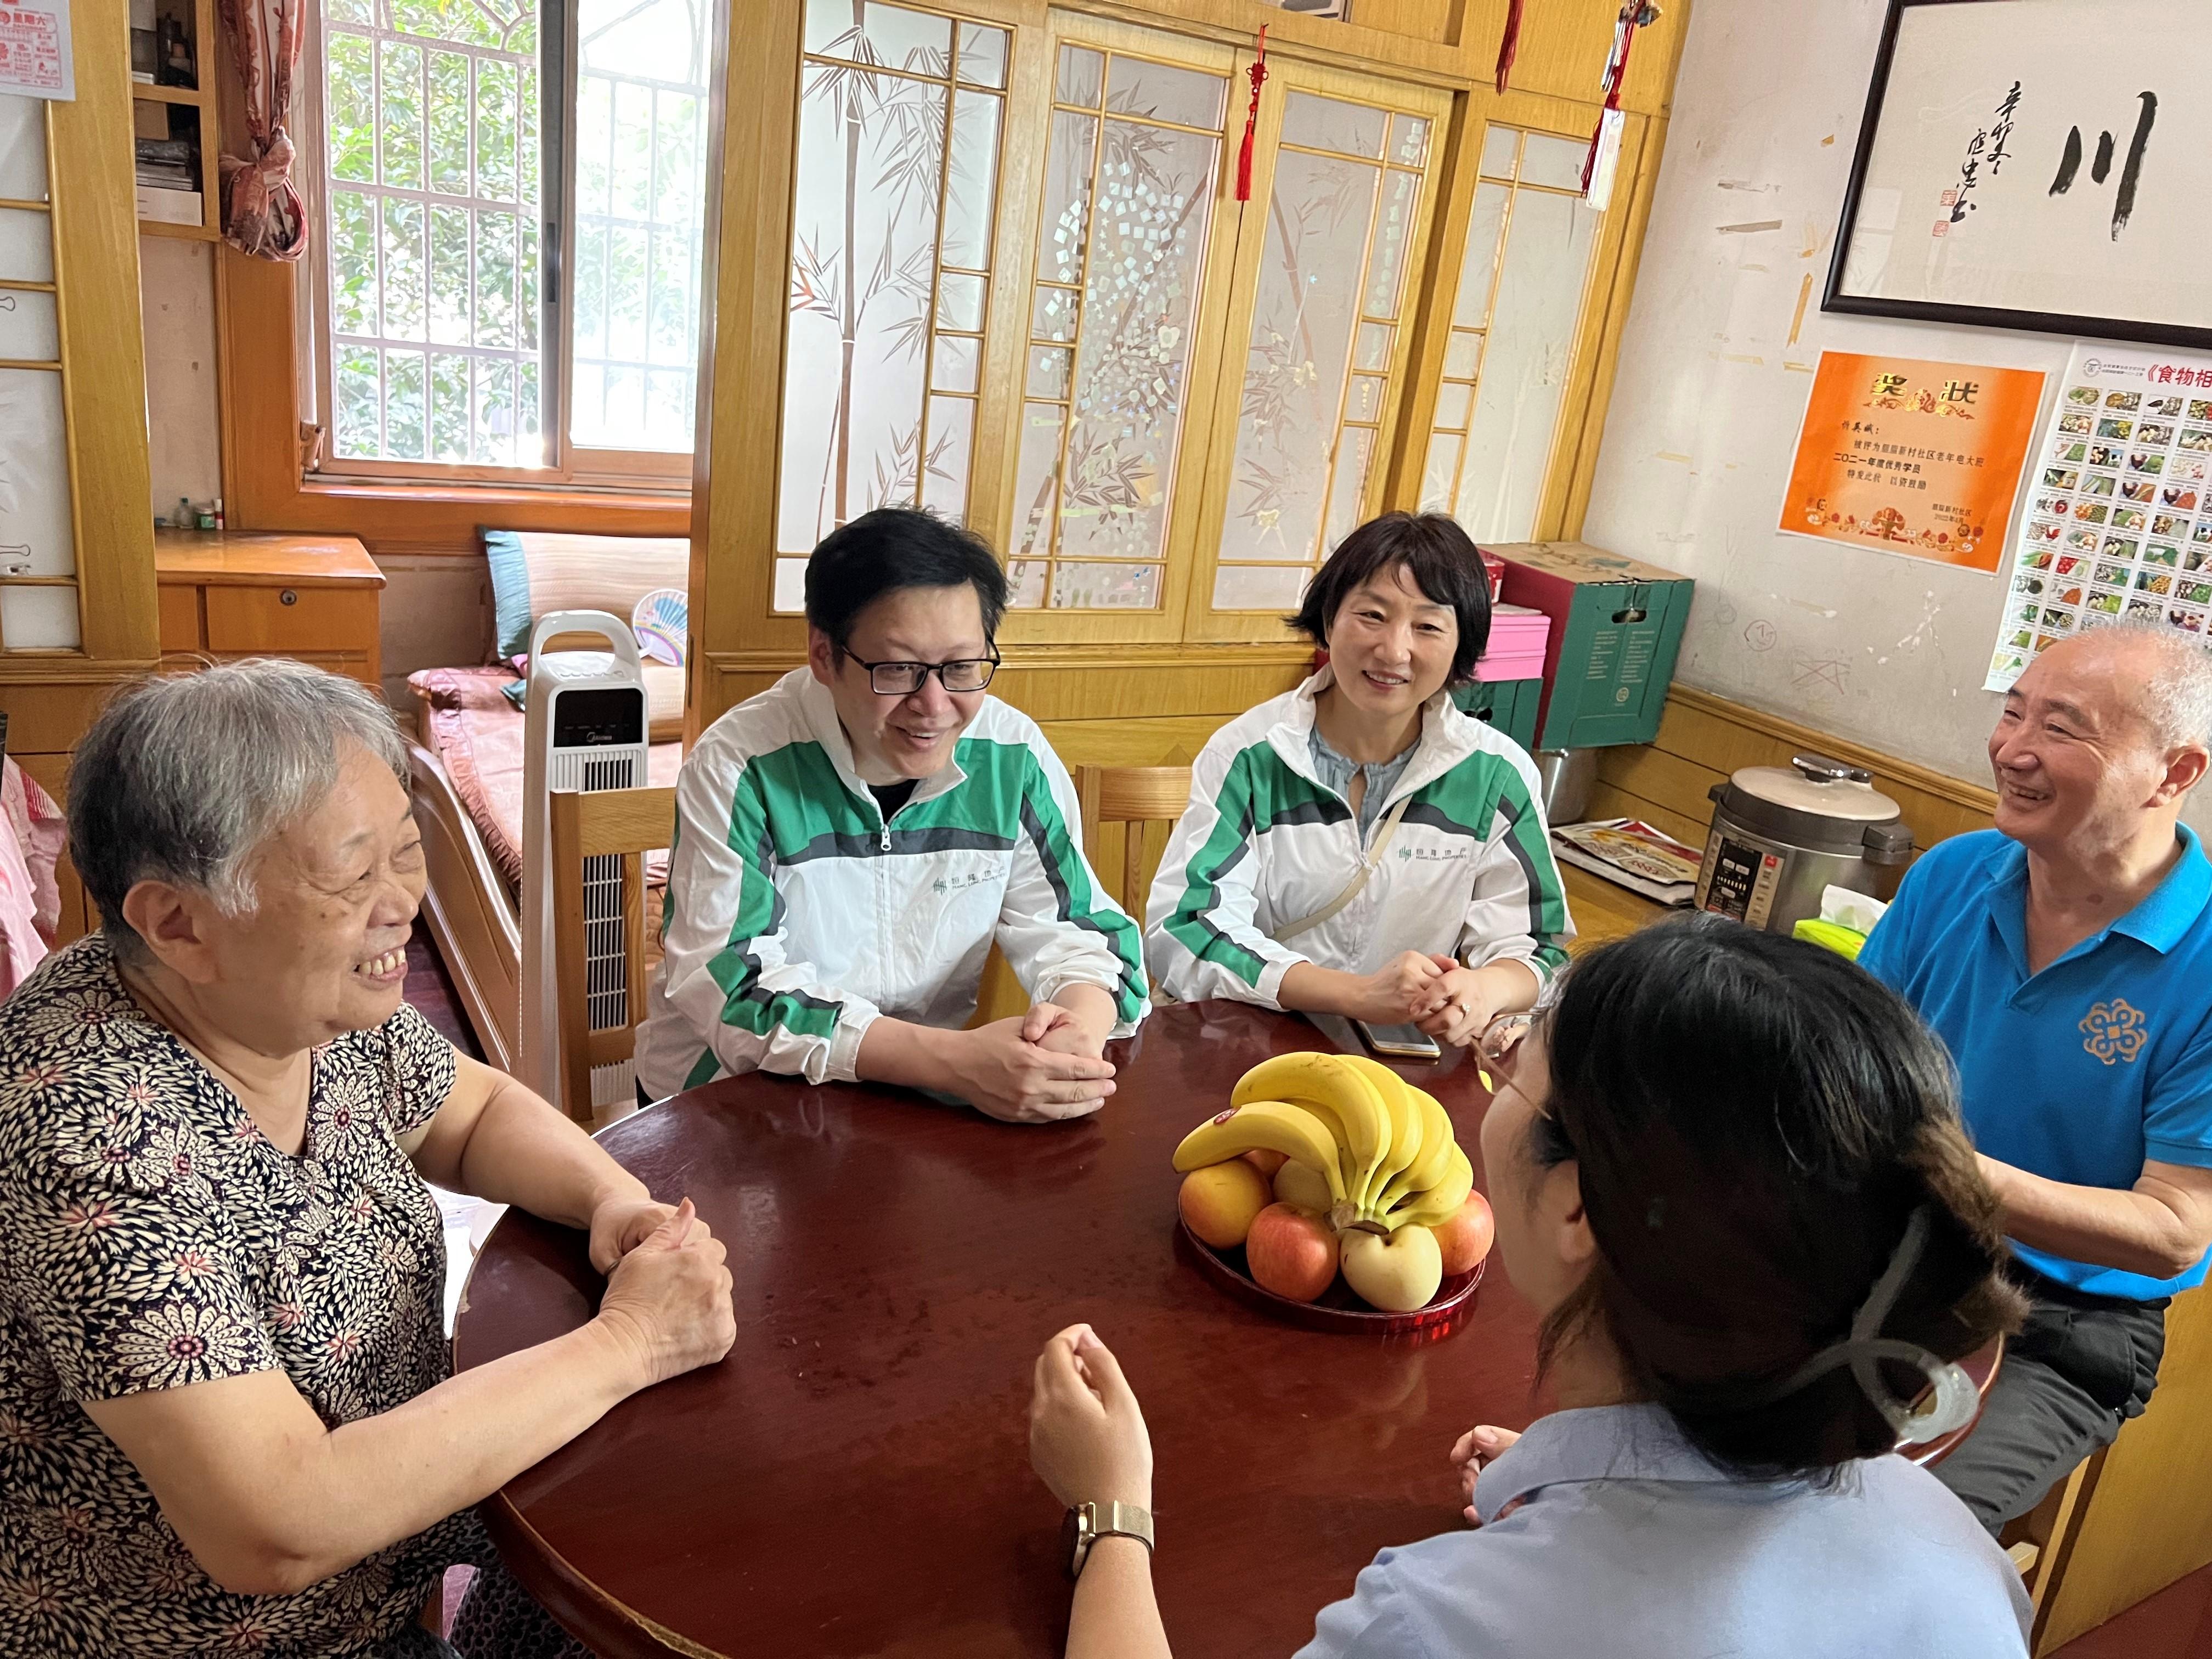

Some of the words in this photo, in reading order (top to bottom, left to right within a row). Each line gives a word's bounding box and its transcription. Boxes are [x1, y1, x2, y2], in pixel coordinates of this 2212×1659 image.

[2049, 91, 2158, 242] 川
[2148, 364, 2212, 388] 《食物相
